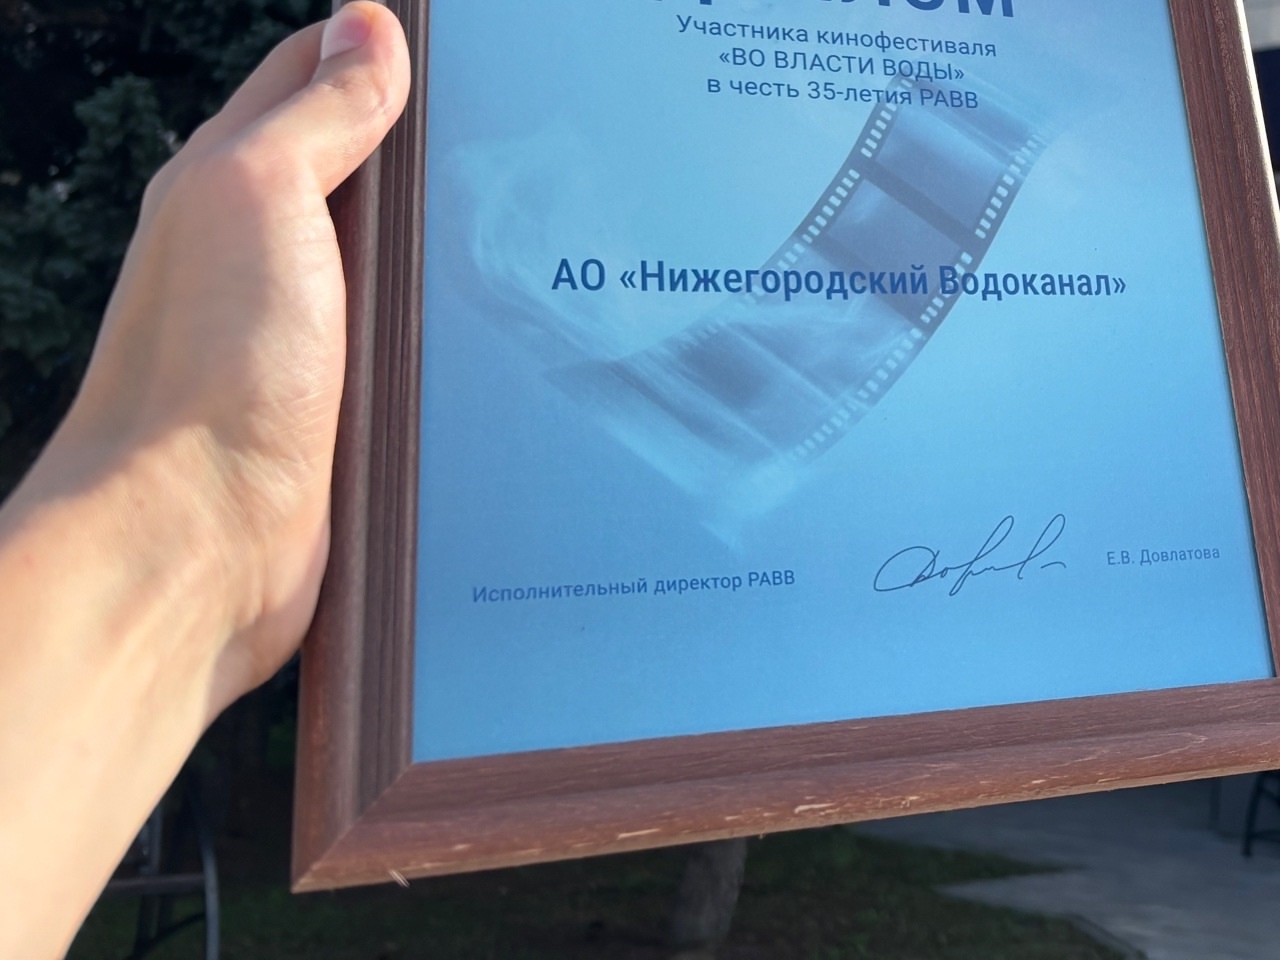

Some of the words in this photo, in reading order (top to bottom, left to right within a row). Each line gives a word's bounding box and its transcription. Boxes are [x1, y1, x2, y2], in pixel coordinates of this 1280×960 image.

[676, 14, 809, 43] Участника
[816, 25, 997, 58] кинофестиваля
[719, 47, 766, 69] «ВО
[774, 51, 875, 76] ВЛАСТИ
[883, 59, 965, 82] ВОДЫ»
[707, 78, 721, 93] в
[729, 80, 800, 99] честь
[806, 82, 912, 106] 35-летия
[920, 87, 979, 109] РАВВ
[551, 257, 607, 292] АО
[620, 259, 929, 301] «Нижегородский
[938, 265, 1127, 302] Водоканал»
[1107, 551, 1135, 566] Е.В.
[1140, 548, 1221, 566] Довлатова
[472, 578, 648, 603] Исполнительный
[653, 574, 743, 595] директор
[748, 569, 796, 588] РАВВ
